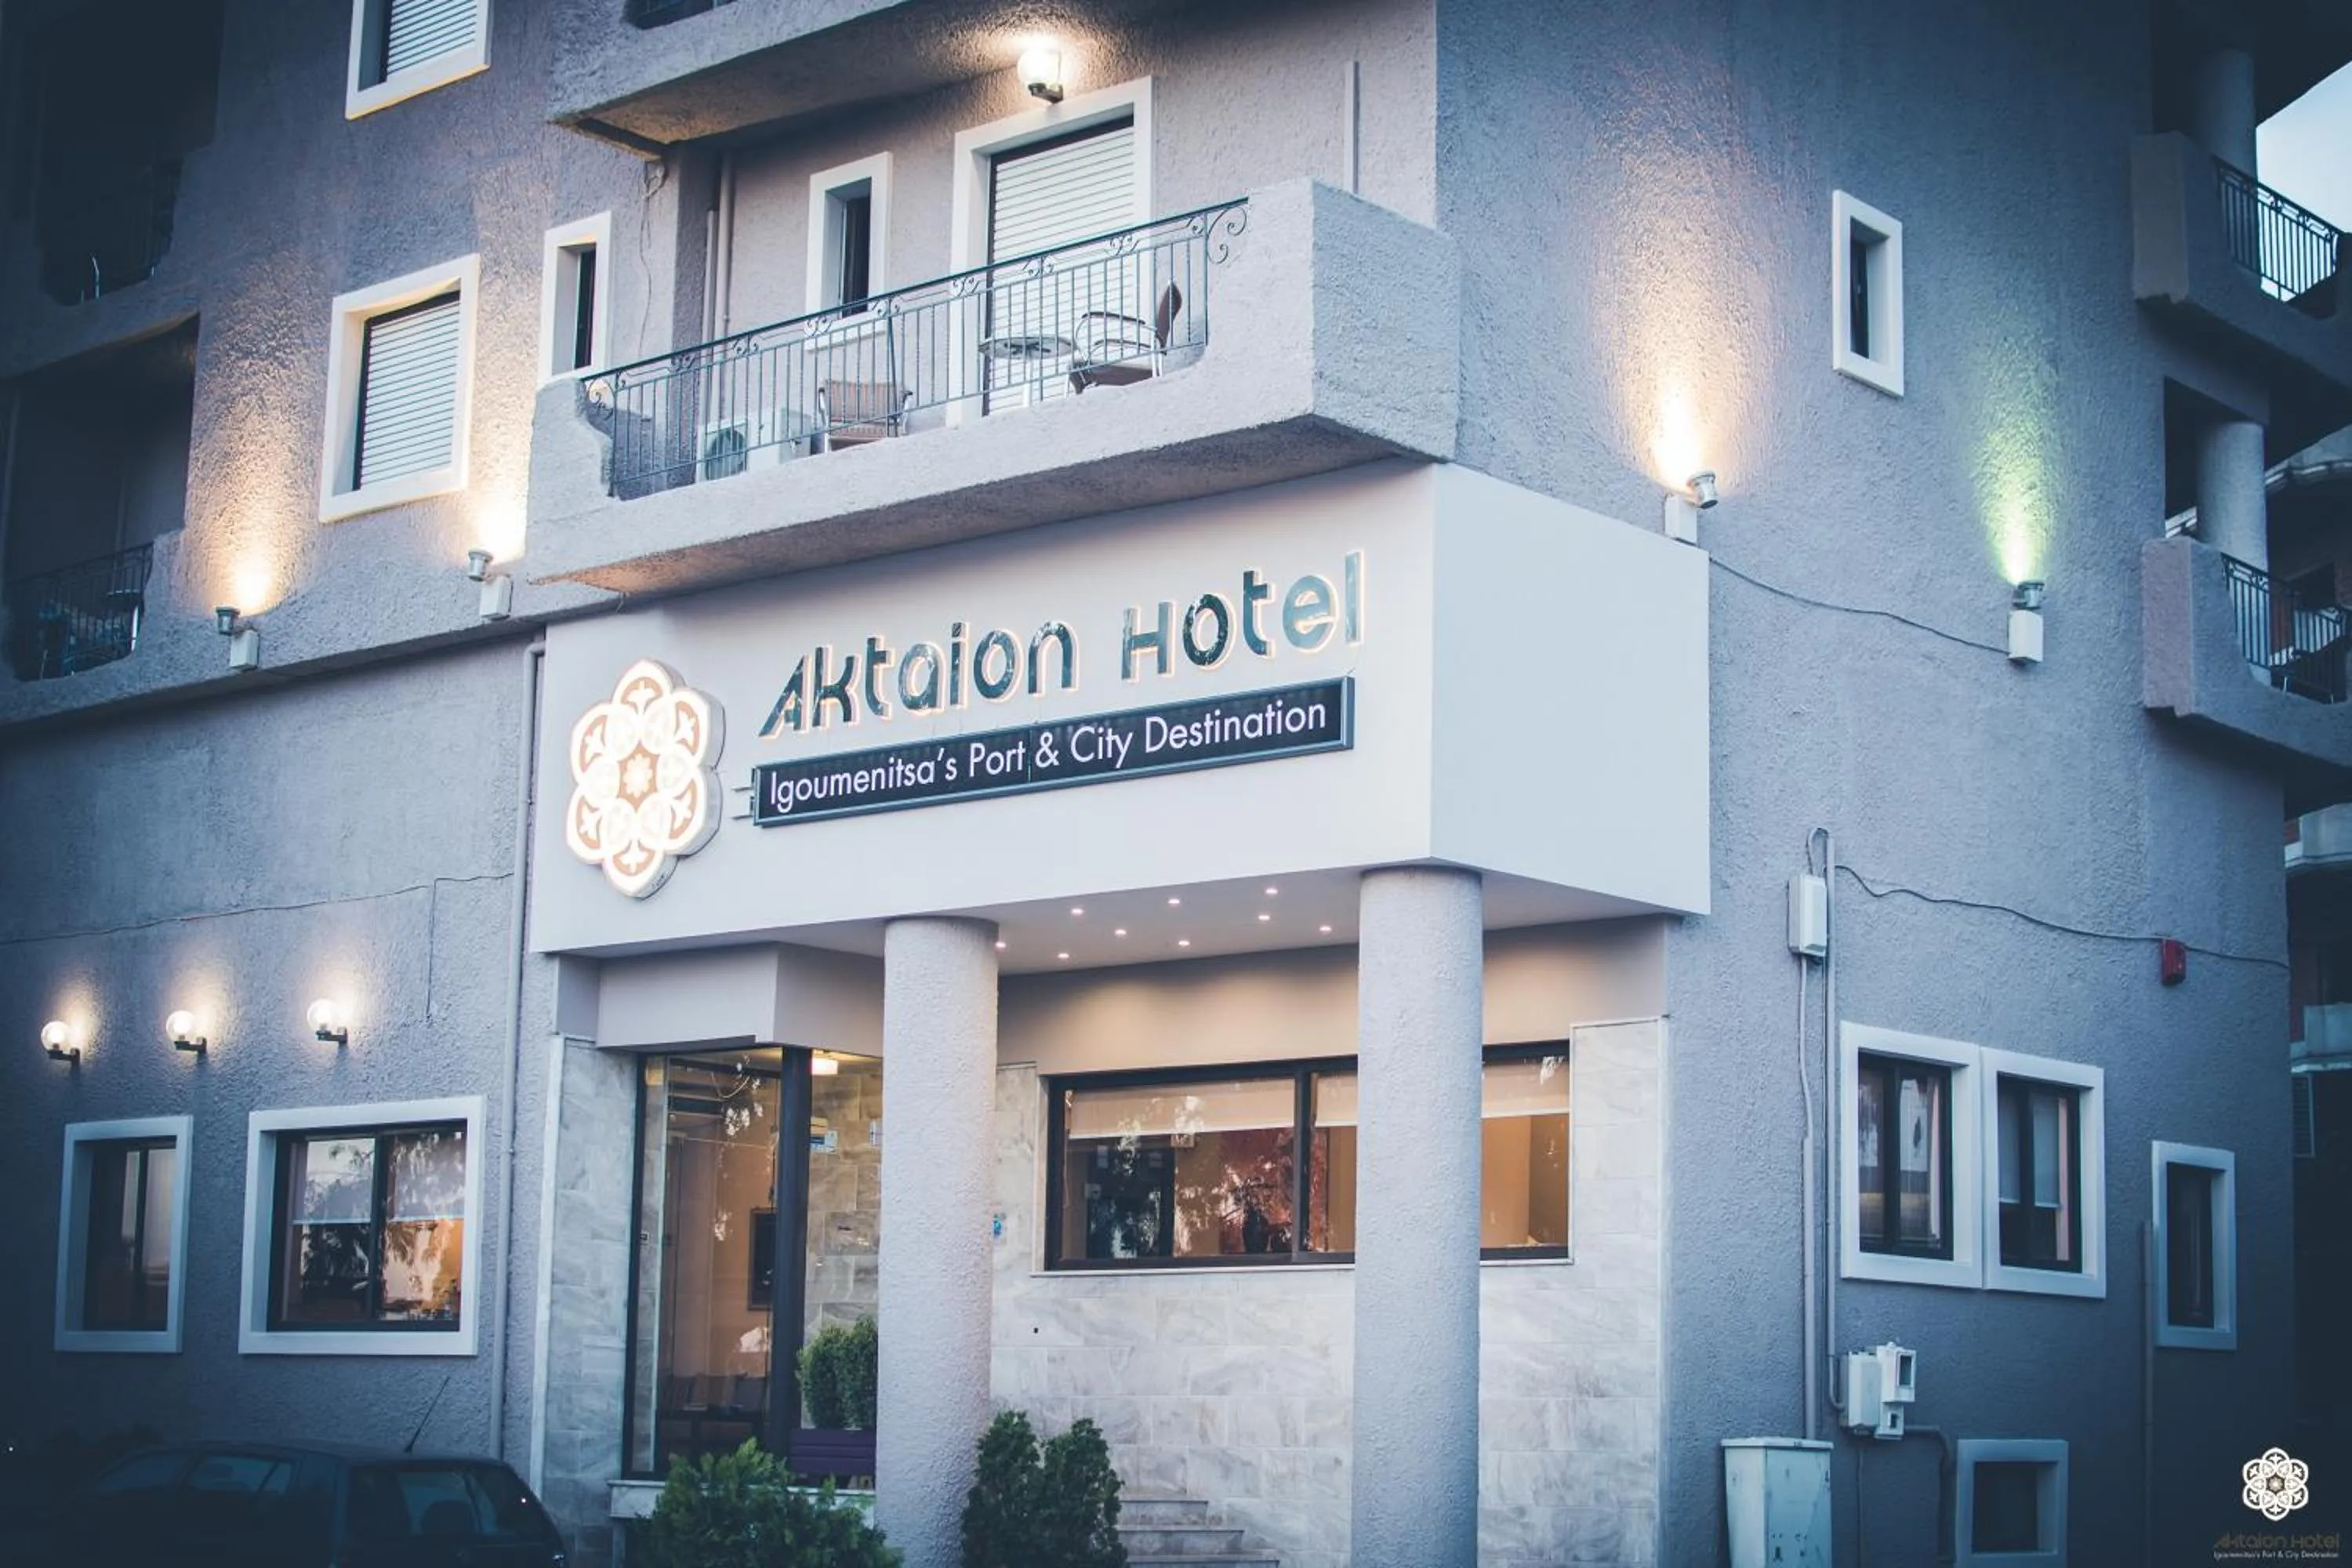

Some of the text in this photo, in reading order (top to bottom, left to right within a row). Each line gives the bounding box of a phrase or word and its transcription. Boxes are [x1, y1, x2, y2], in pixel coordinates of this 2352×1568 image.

[759, 550, 1364, 739] Aktaion Hotel
[771, 699, 1326, 813] Igoumenitsa's Port & City Destination
